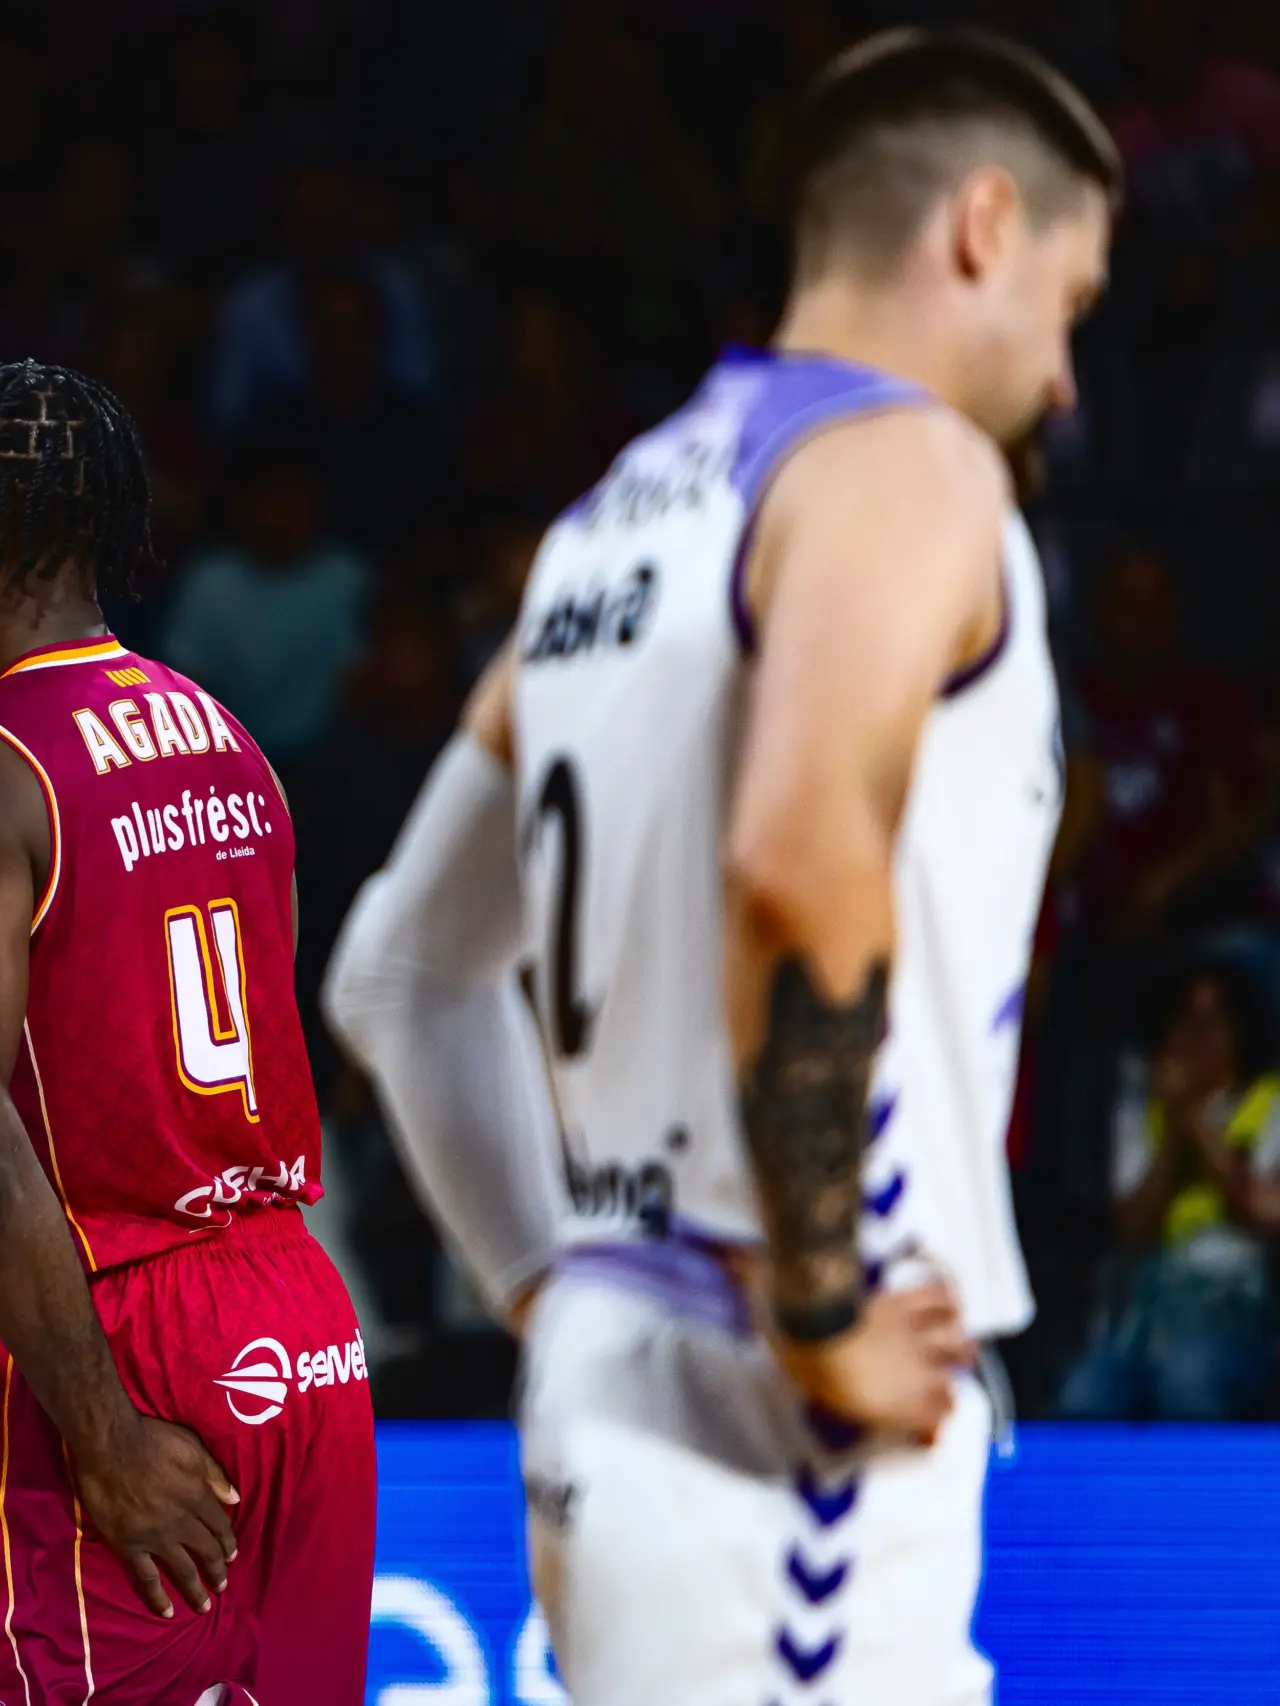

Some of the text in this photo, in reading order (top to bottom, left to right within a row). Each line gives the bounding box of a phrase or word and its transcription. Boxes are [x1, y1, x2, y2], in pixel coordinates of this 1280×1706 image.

[72, 690, 242, 775] AGADA
[216, 846, 255, 861] de Lleida
[164, 897, 260, 1124] 4
